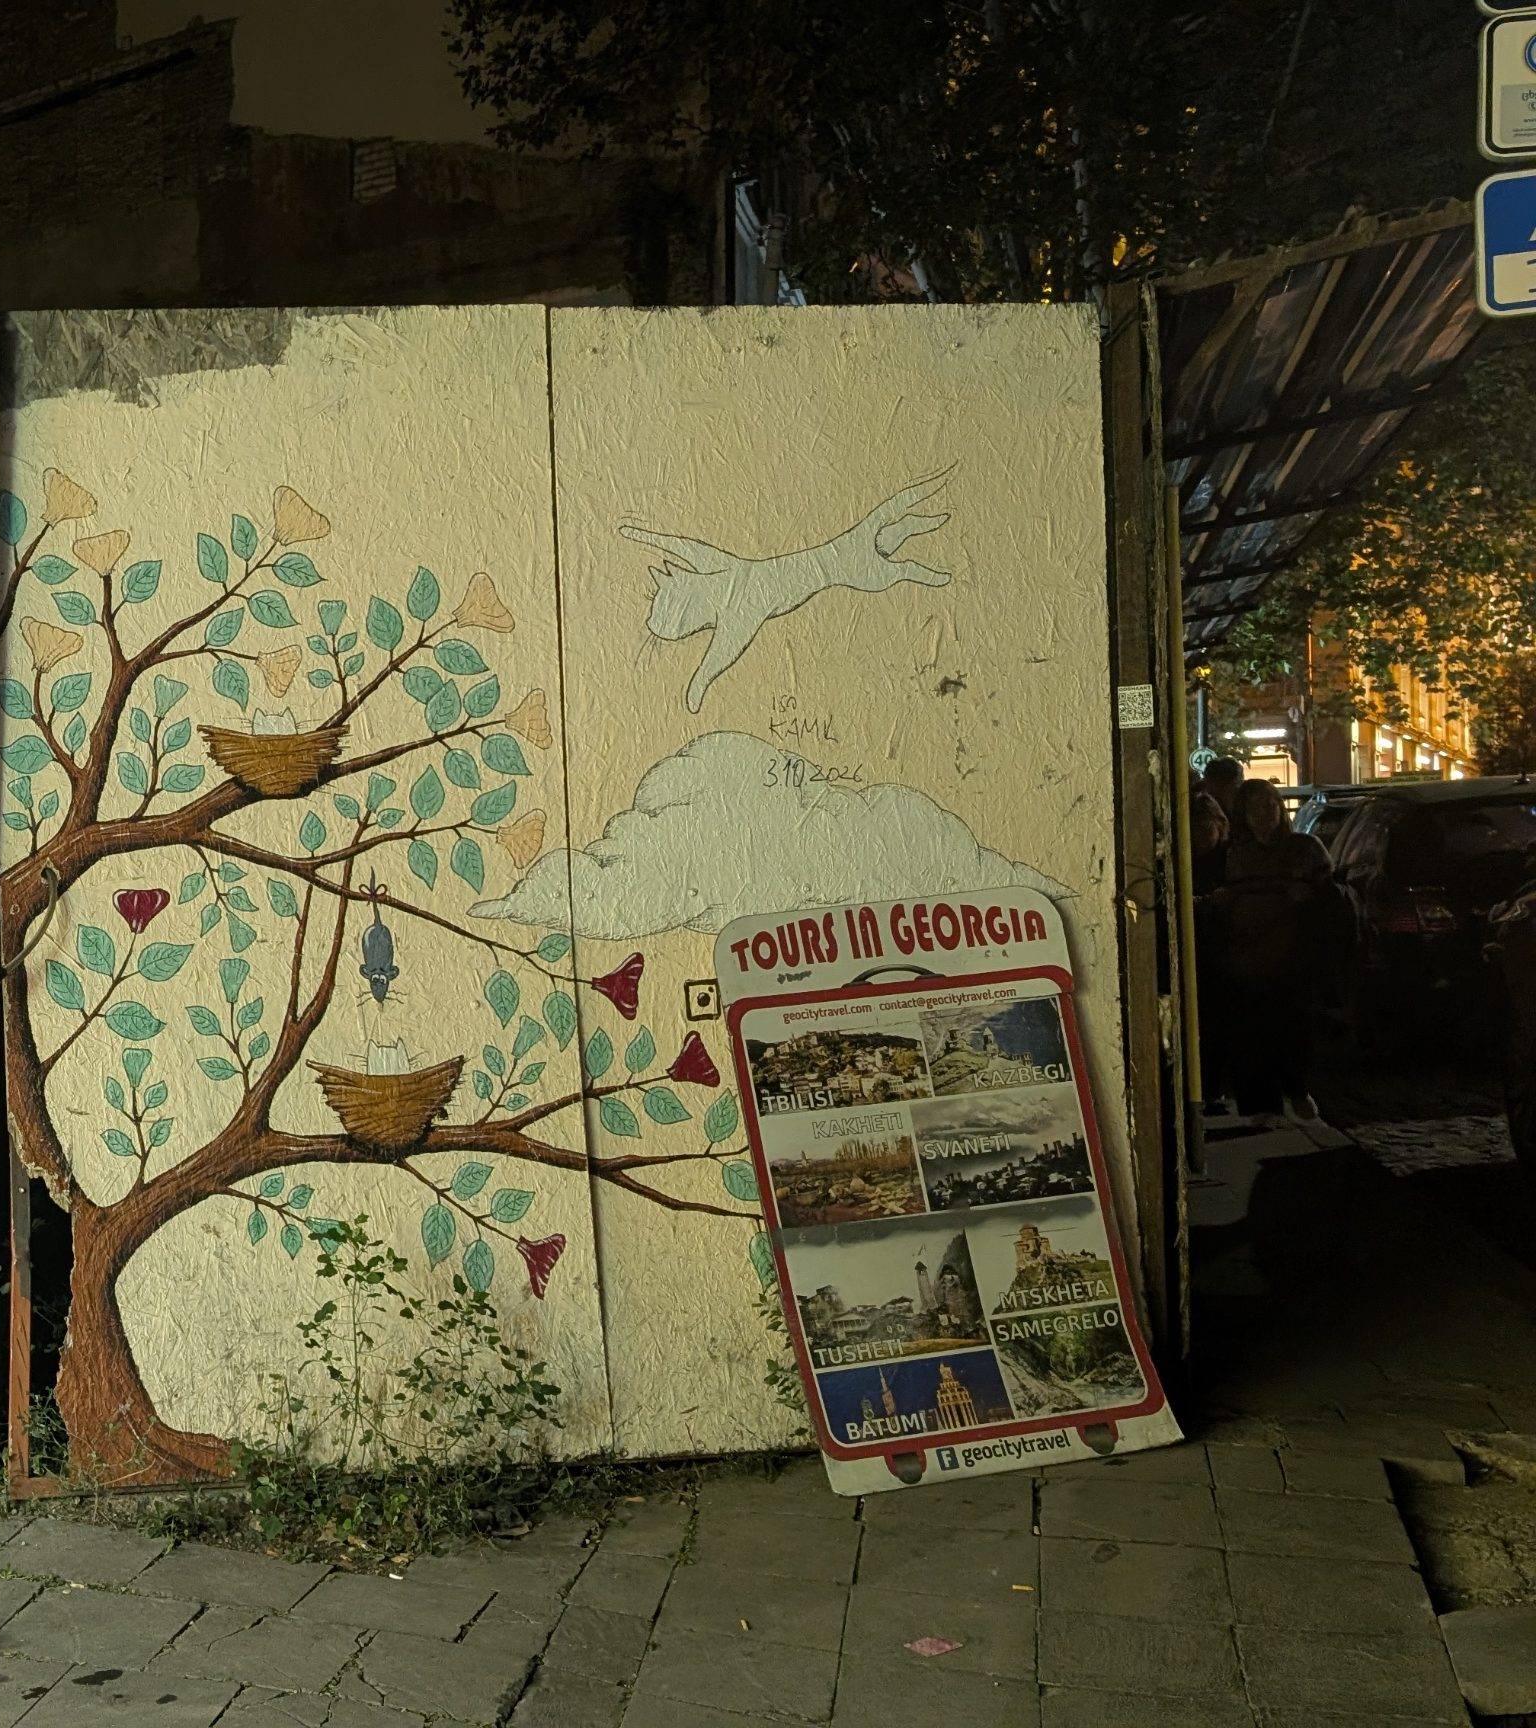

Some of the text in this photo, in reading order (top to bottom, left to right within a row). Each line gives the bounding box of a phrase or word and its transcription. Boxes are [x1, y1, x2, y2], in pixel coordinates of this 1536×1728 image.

[730, 903, 1048, 973] TOURS IN GEORGIA
[783, 987, 1017, 1024] geocitytravel.com contact@geocitytravel.com
[973, 1062, 1066, 1090] KAZBEGI
[762, 1093, 835, 1113] TBILISI
[811, 1112, 905, 1140] KAKHETI
[922, 1133, 1012, 1161] SVANETI
[998, 1279, 1111, 1309] MTSKHETA
[995, 1308, 1120, 1343] SAMEGRELO
[814, 1338, 906, 1367] TUSHETI
[845, 1410, 928, 1442] BATUMI
[961, 1429, 1071, 1468] geocitytravel
